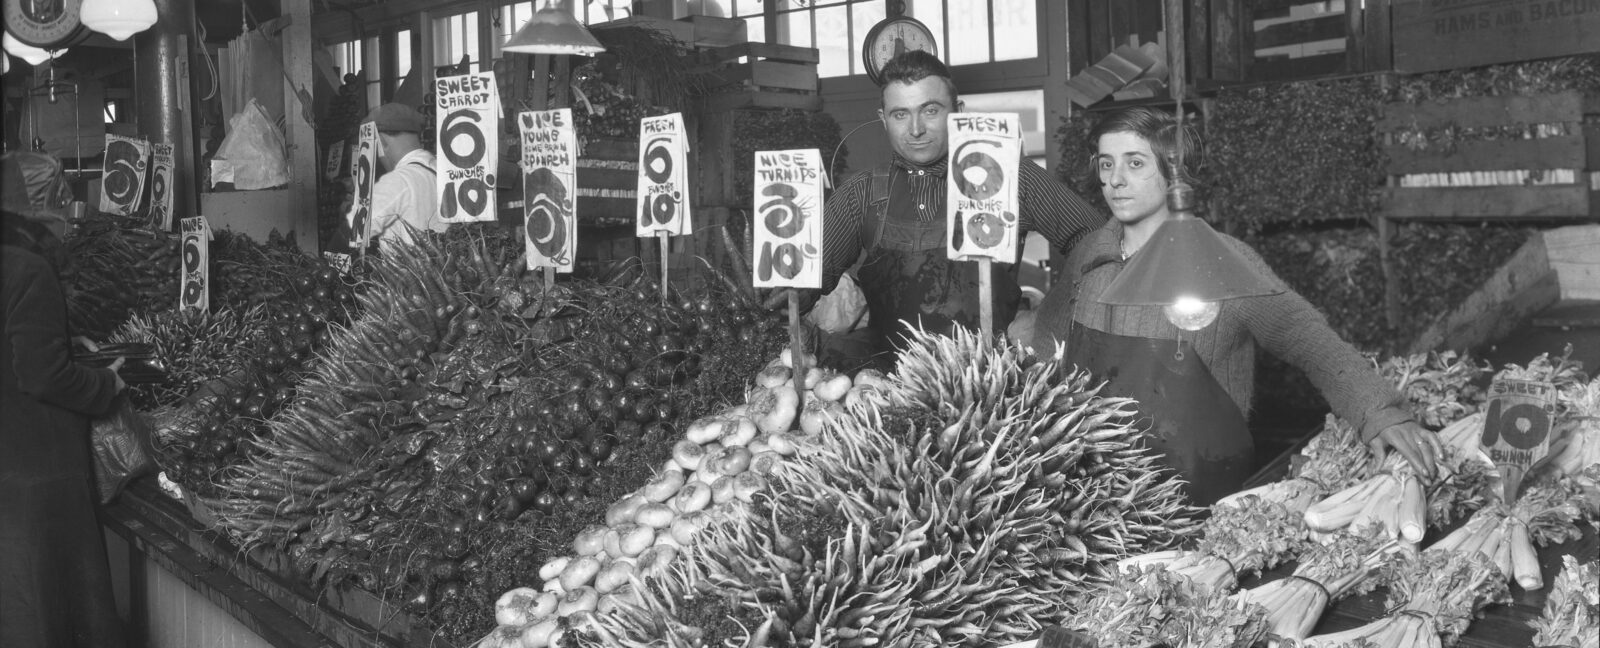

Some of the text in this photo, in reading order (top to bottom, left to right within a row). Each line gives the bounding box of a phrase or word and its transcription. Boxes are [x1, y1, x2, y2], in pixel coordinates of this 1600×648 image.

[1434, 11, 1490, 35] HAMS
[1495, 10, 1523, 26] AND
[437, 76, 491, 96] SWEET
[437, 92, 490, 109] CARROT
[522, 112, 564, 129] NICE
[643, 119, 675, 135] FRESH
[953, 117, 1009, 134] FRESH
[440, 109, 486, 169] 6
[523, 129, 559, 144] YOUNG
[524, 153, 569, 168] SPINACH
[643, 137, 673, 184] 6
[758, 153, 807, 169] NICE
[446, 165, 485, 180] BUNCHES
[757, 168, 817, 183] TURNIPS
[952, 140, 1004, 200] 6
[152, 165, 166, 201] 6
[957, 199, 1003, 212] BUNCHES
[183, 234, 200, 273] 6
[1494, 381, 1550, 395] SWEET
[1490, 449, 1533, 466] BUNCH
